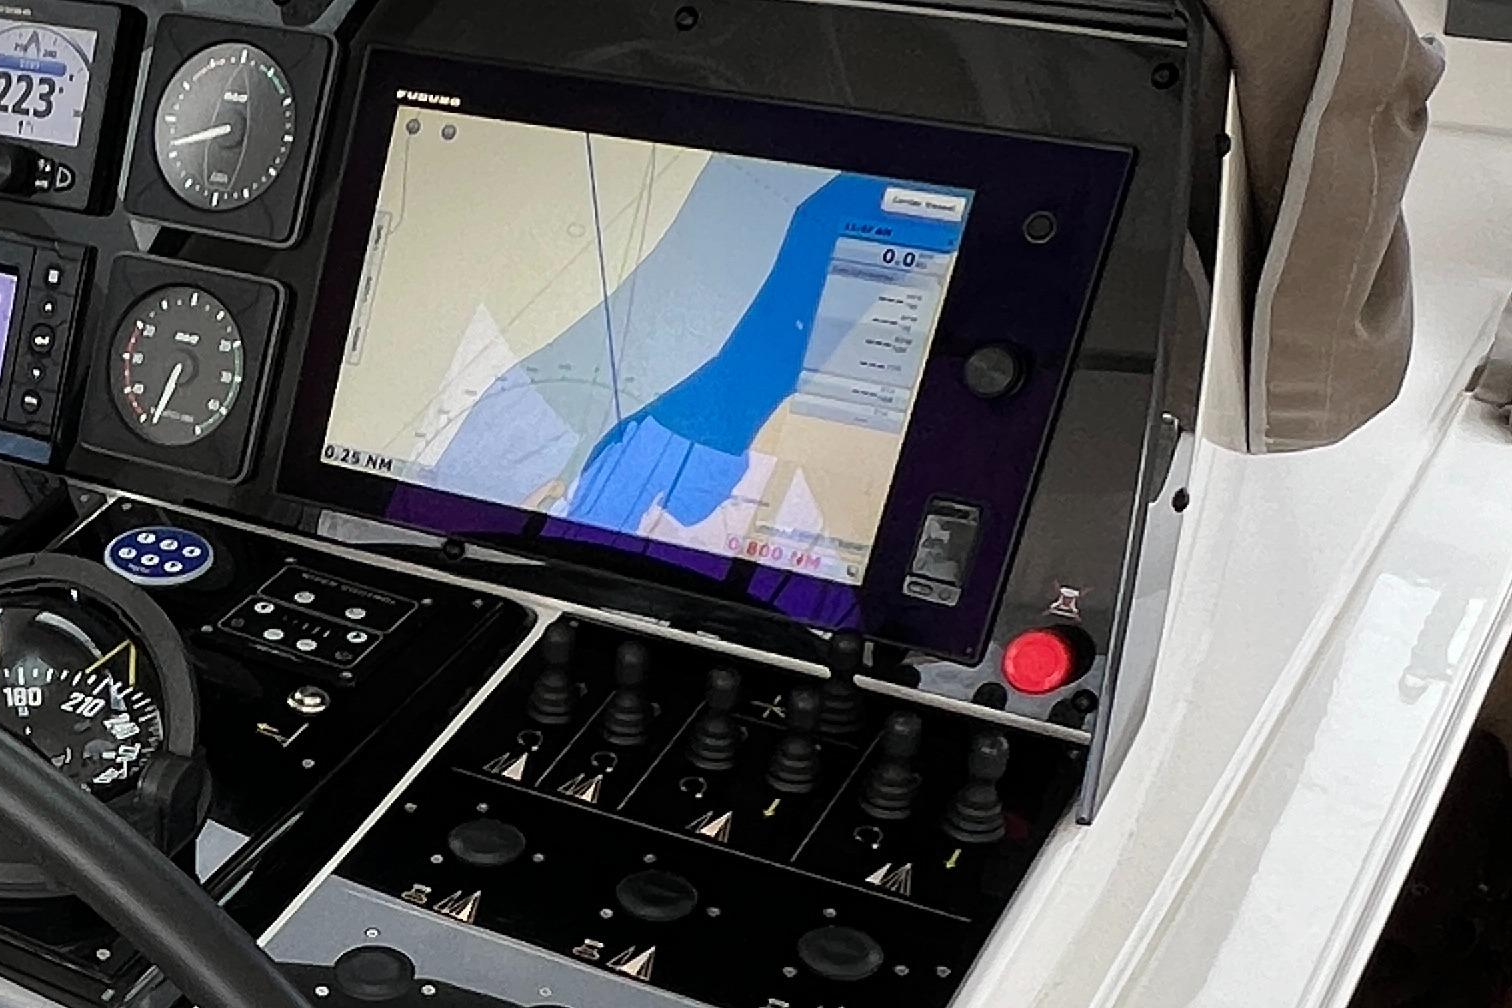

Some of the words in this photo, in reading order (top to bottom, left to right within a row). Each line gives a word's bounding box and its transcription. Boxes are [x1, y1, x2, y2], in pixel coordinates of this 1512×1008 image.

[364, 454, 394, 472] NM
[2, 686, 43, 708] 180
[60, 691, 106, 718] 210
